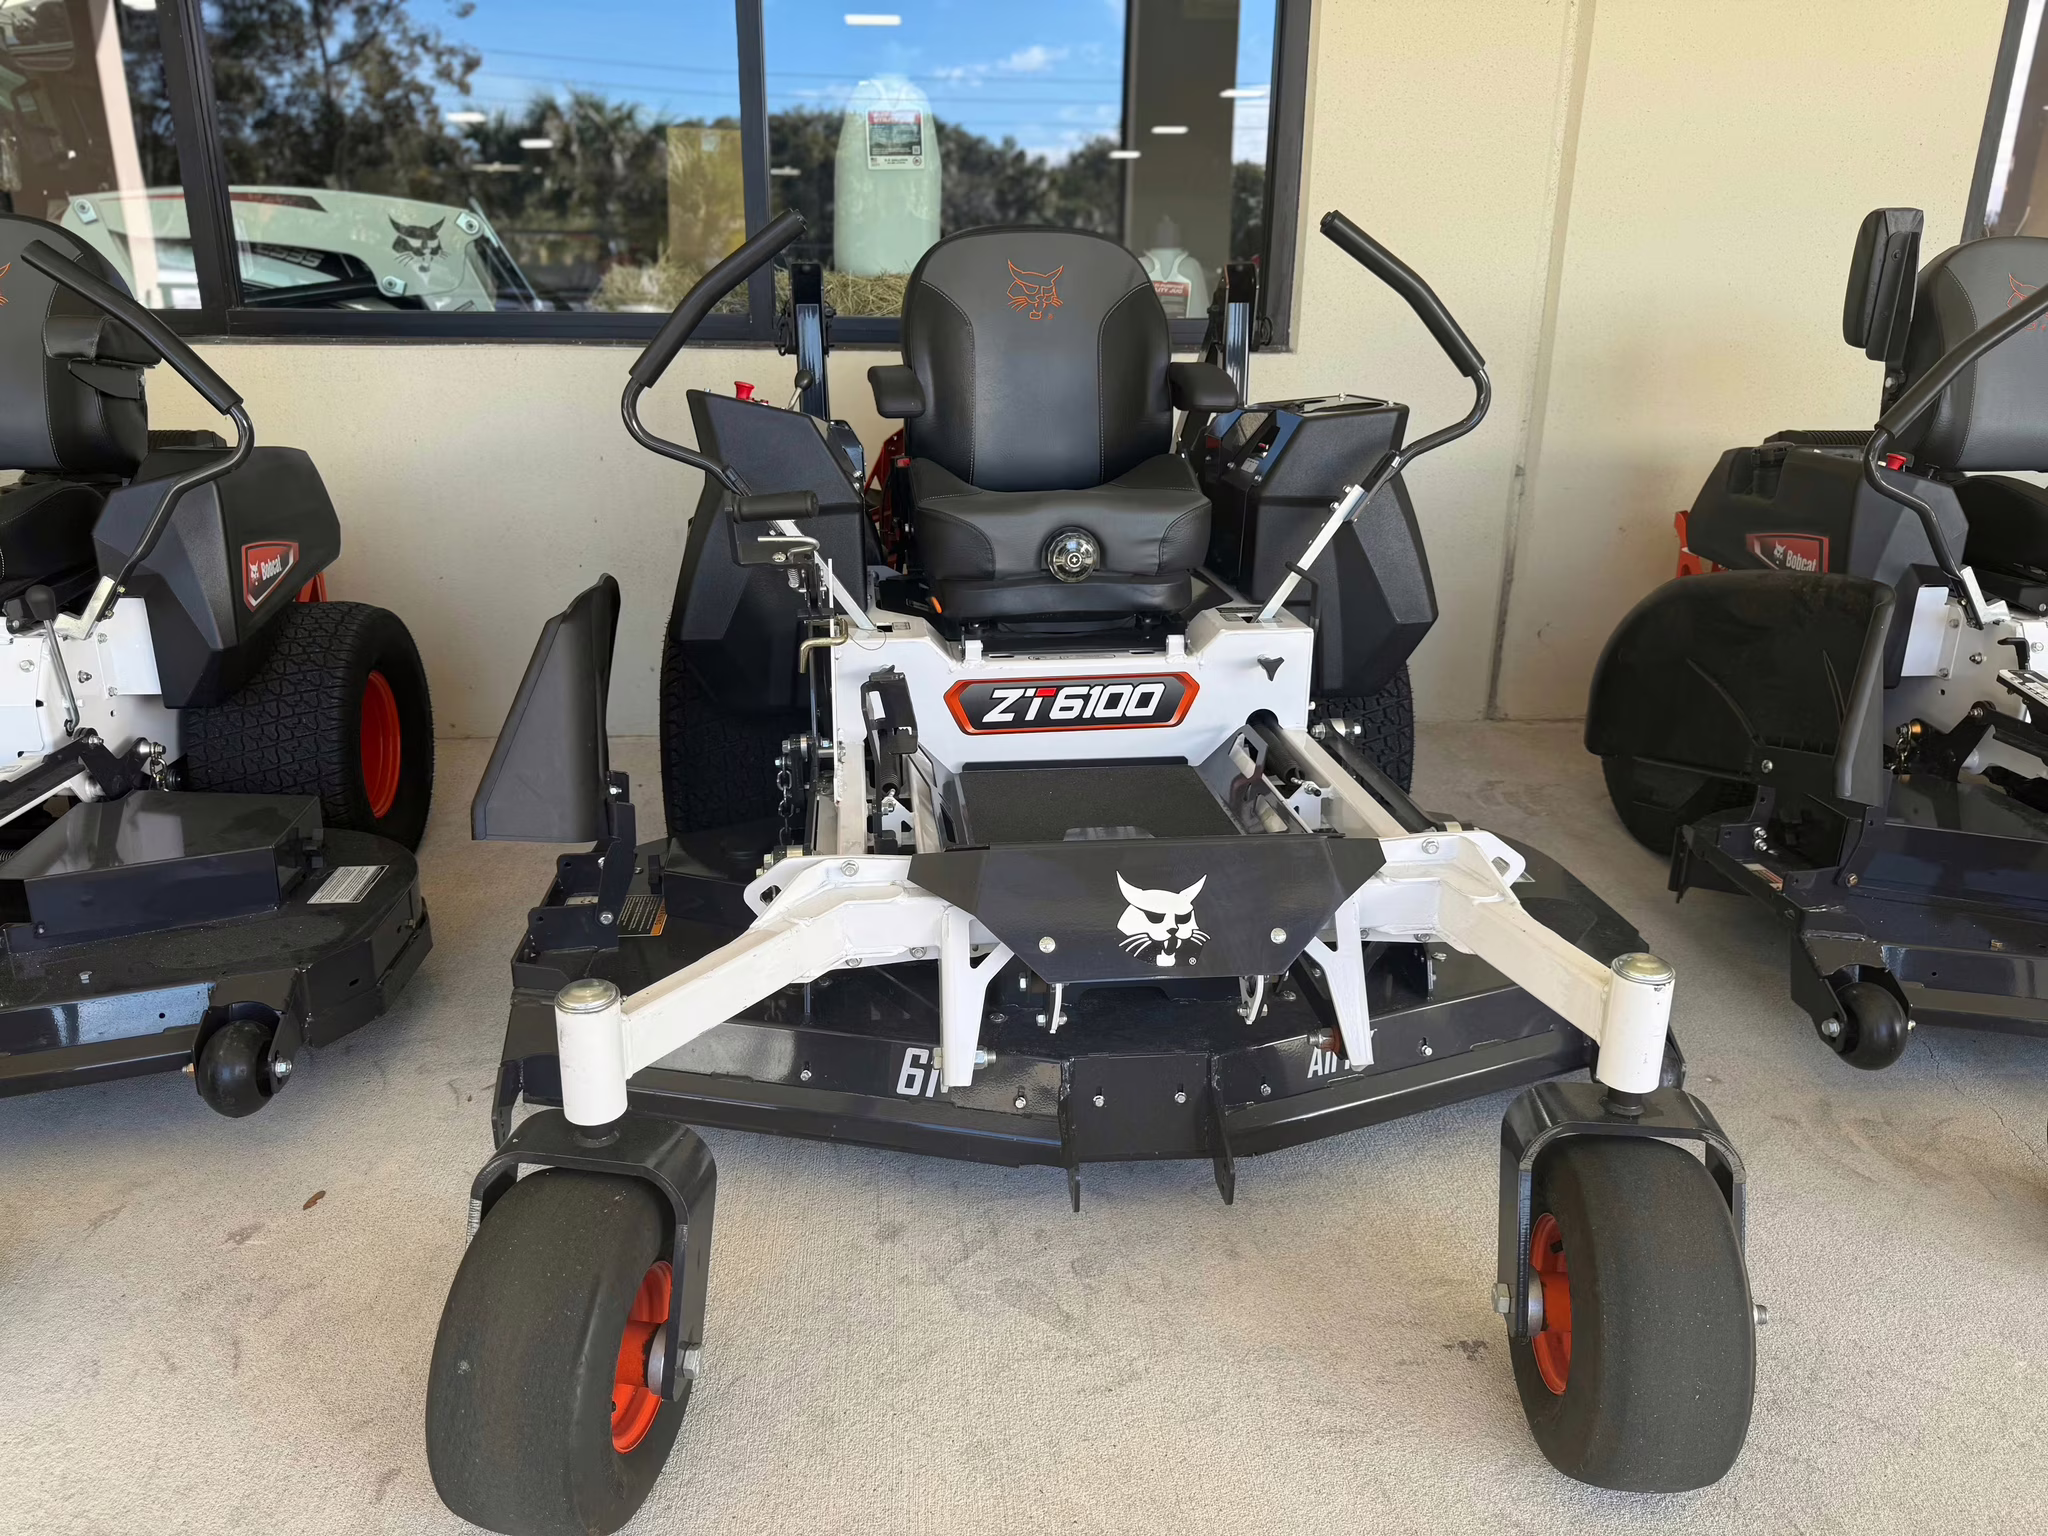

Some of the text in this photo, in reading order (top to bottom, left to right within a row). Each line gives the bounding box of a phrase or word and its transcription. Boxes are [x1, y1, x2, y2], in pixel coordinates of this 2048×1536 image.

[261, 554, 282, 580] Bobcat
[1785, 550, 1817, 572] Bobcat
[981, 682, 1166, 723] ZT6100
